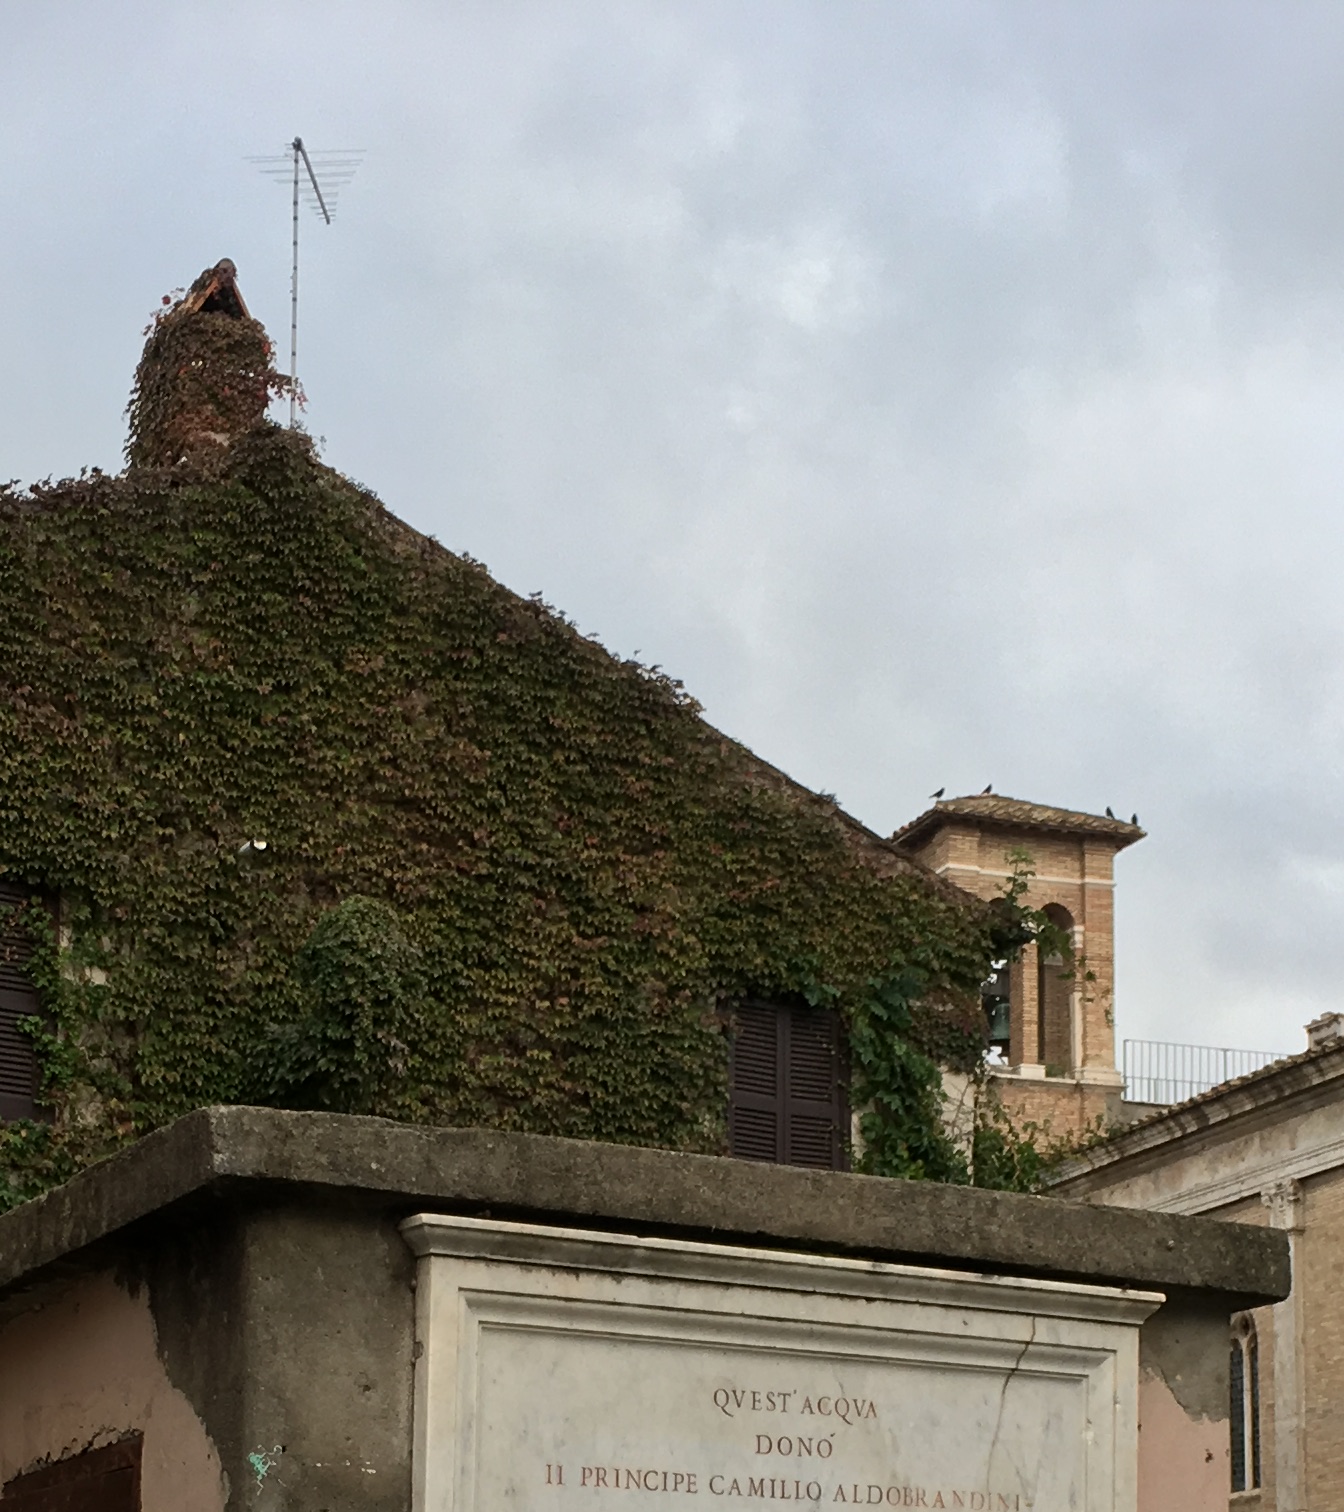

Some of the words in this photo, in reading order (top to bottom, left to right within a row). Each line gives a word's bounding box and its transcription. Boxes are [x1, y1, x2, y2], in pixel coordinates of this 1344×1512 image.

[580, 1466, 699, 1494] PRINCIPE
[709, 1475, 823, 1502] CAMILLO
[832, 1483, 1021, 1512] ALDOBRANDINI
